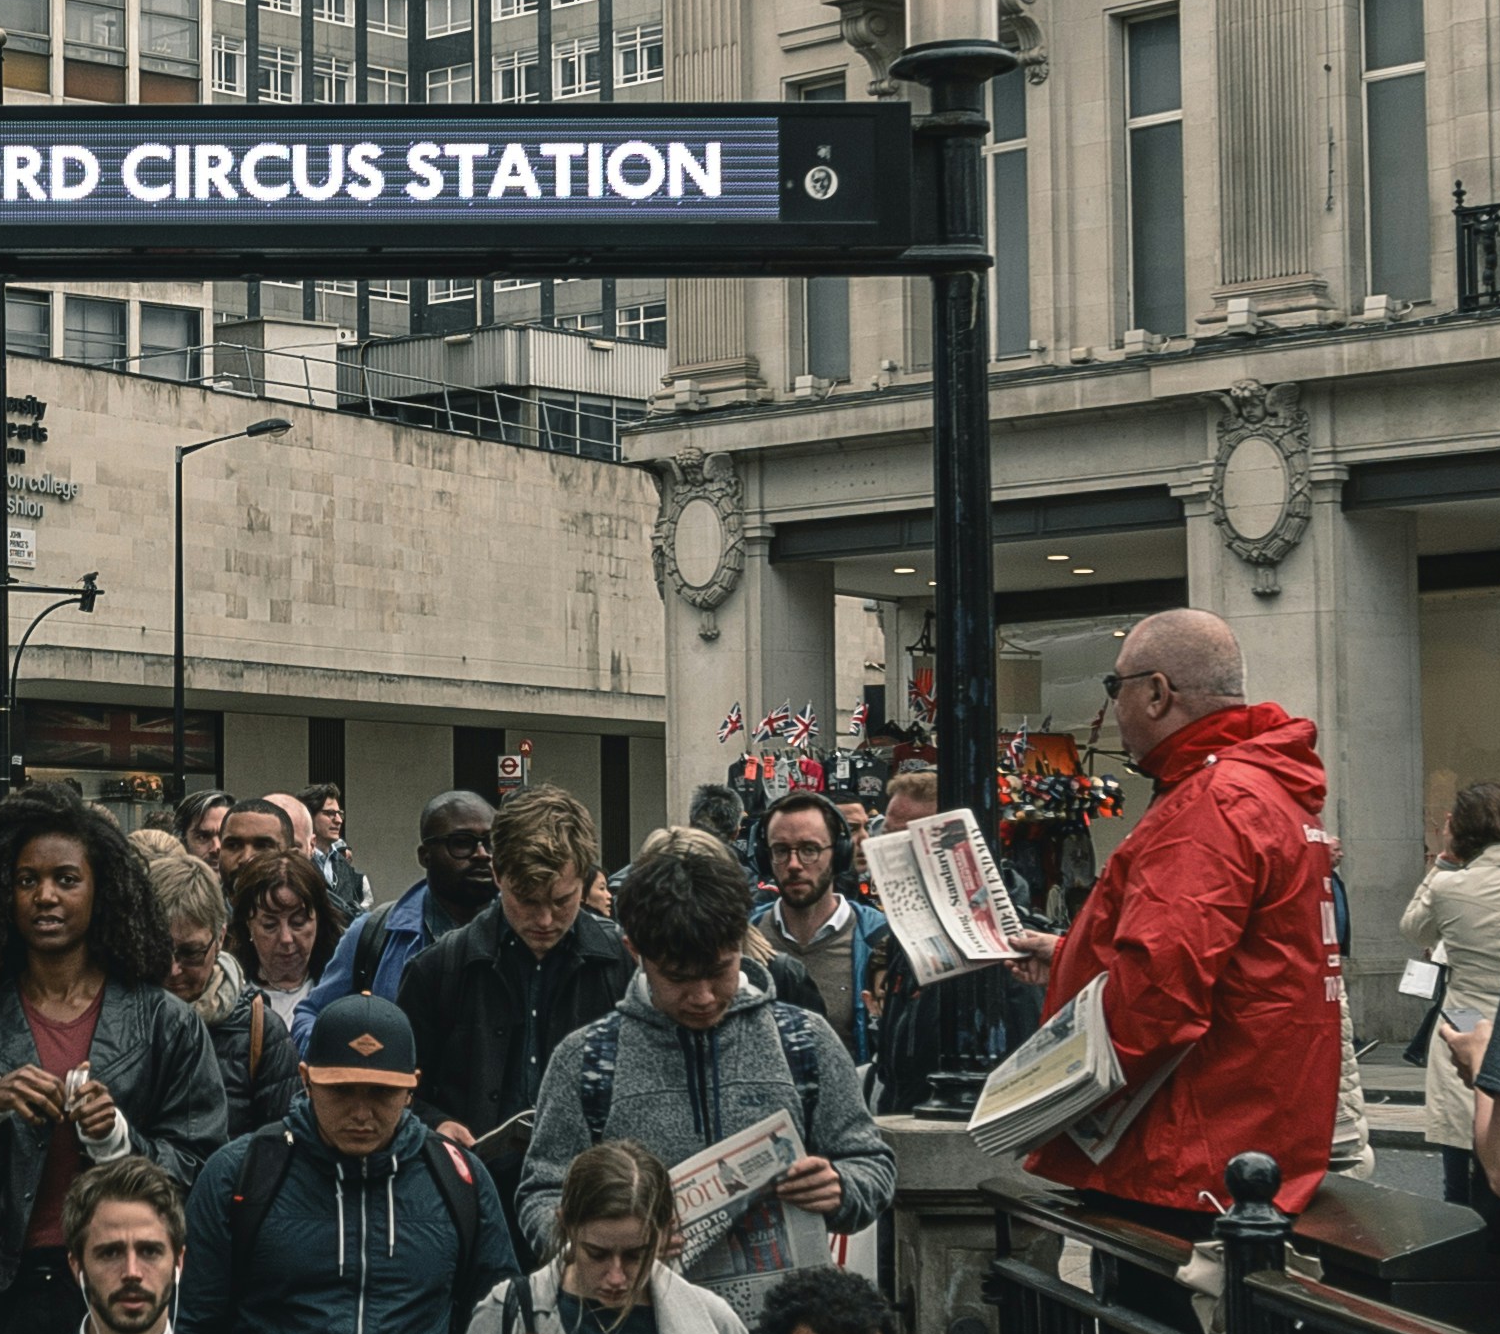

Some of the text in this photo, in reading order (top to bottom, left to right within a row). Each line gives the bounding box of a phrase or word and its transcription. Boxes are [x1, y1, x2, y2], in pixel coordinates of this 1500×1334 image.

[121, 141, 384, 201] CIRCUS
[404, 140, 722, 201] STATION
[28, 471, 79, 500] college
[10, 531, 21, 539] JOHN
[9, 549, 25, 558] STREET
[931, 847, 961, 908] Standard
[673, 1173, 727, 1220] port
[711, 1209, 729, 1223] TO
